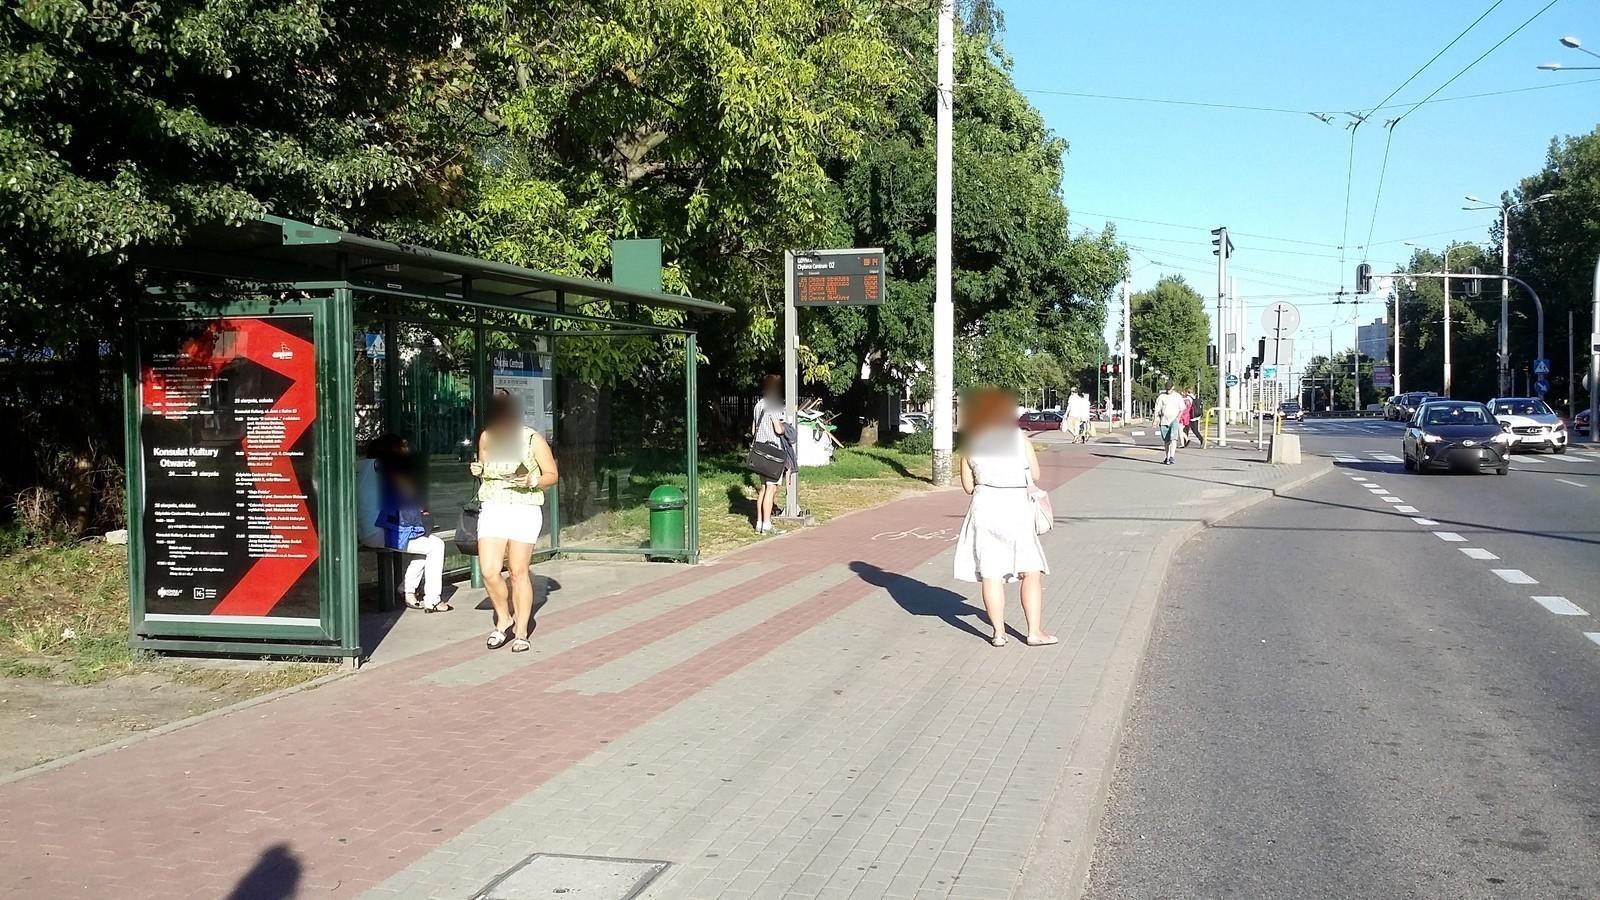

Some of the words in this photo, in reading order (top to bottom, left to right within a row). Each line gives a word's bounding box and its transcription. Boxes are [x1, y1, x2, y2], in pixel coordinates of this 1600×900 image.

[829, 261, 835, 269] 02
[153, 447, 188, 456] Konsulat
[189, 447, 219, 458] Kultury
[160, 459, 197, 468] Otwarcie
